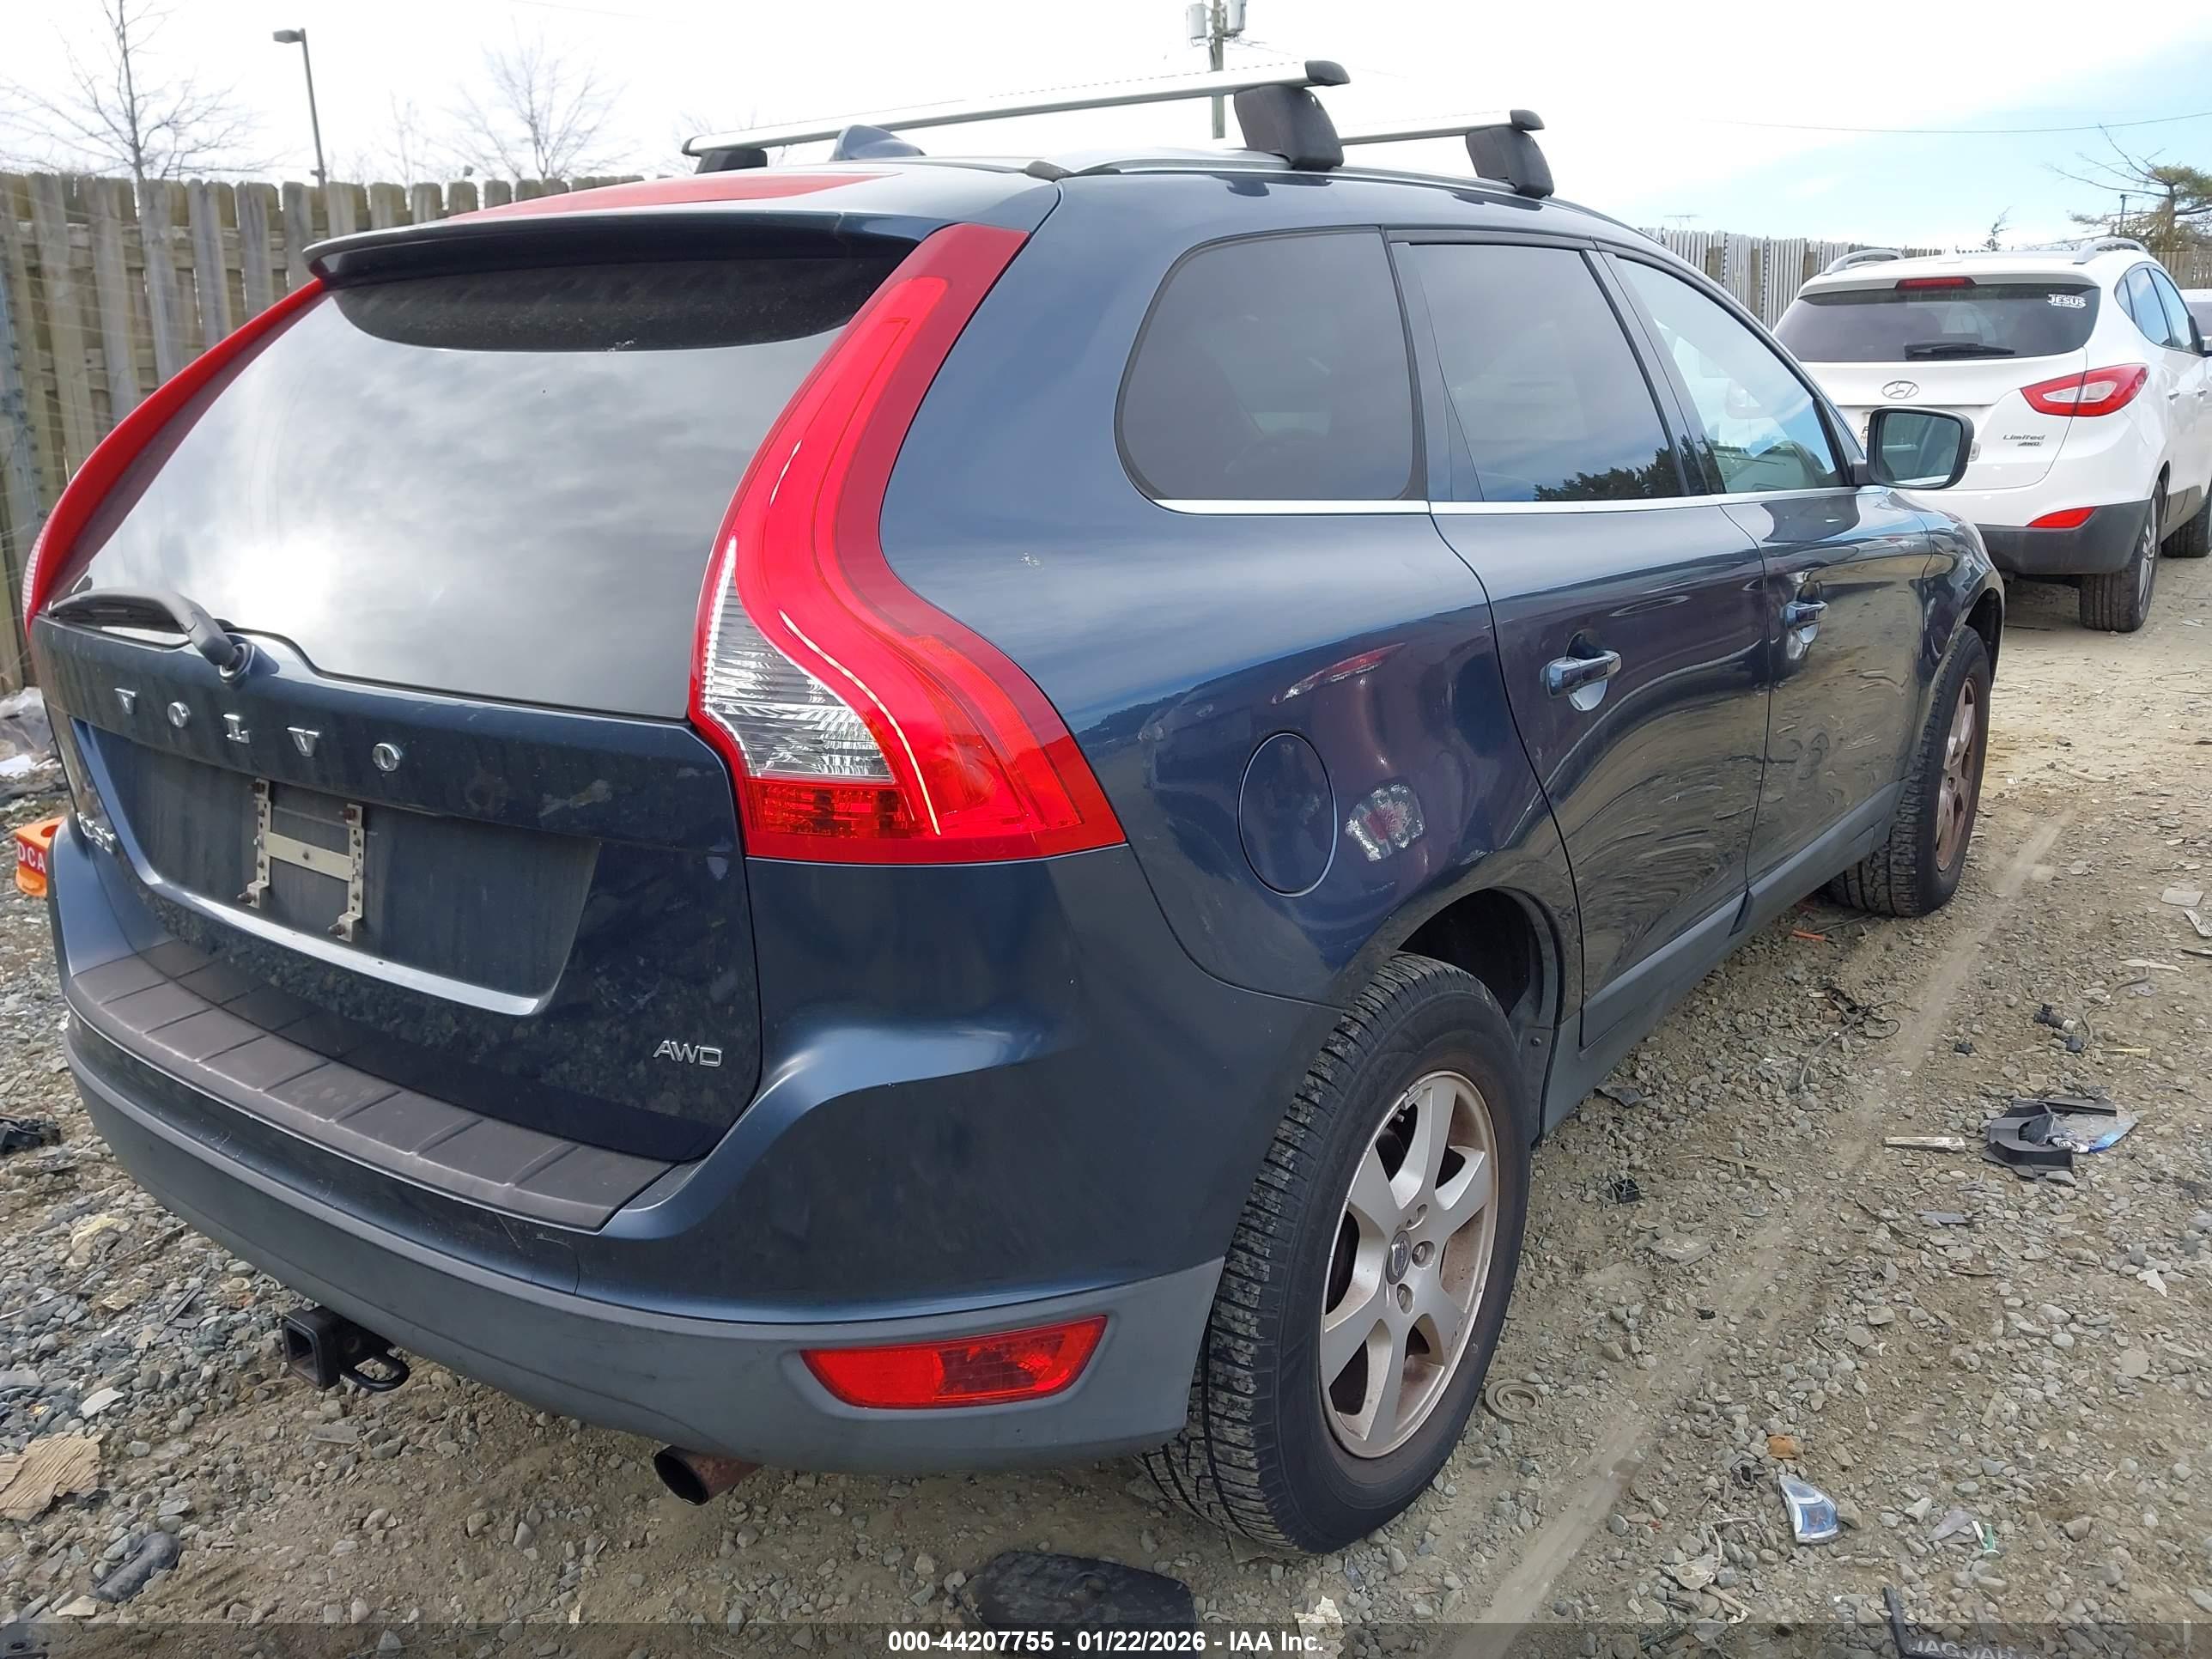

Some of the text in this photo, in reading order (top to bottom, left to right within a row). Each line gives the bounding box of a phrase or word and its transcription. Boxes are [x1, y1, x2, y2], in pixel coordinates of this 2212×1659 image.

[2047, 294, 2087, 307] JESUS
[114, 688, 402, 772] VOLVO
[653, 1040, 722, 1067] AWD
